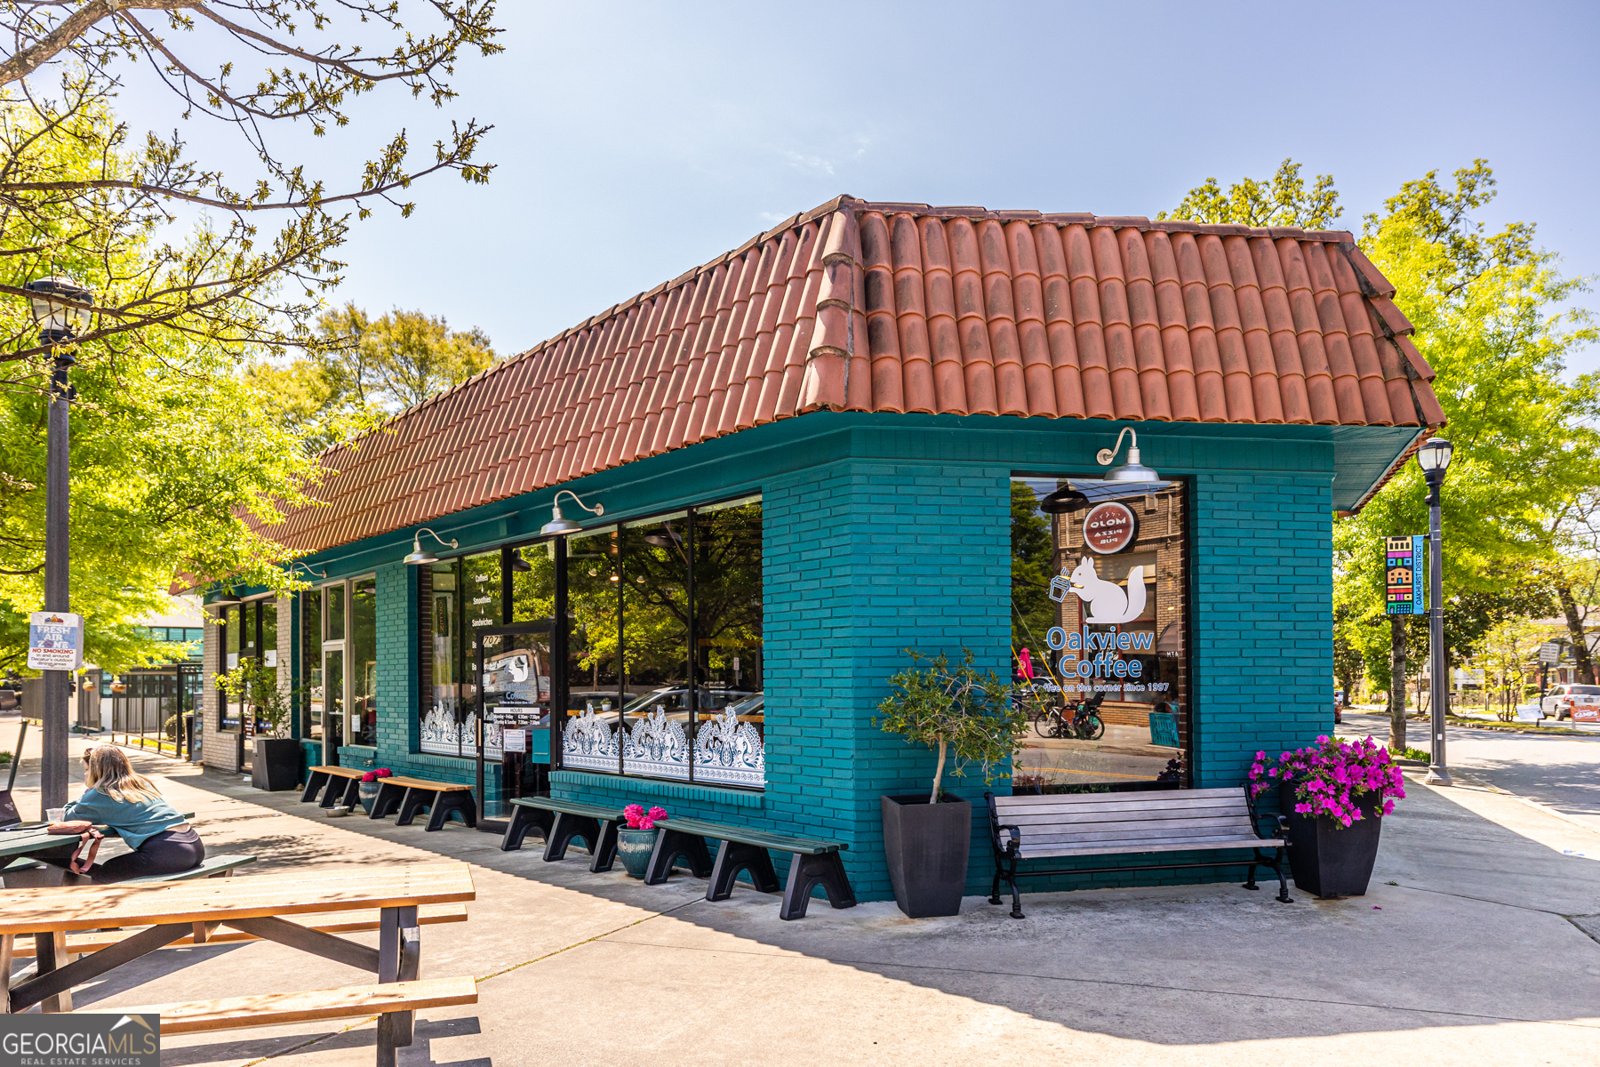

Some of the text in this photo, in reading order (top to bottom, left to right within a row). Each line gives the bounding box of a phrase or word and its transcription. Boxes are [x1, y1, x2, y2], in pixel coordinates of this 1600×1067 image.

[472, 618, 493, 627] Sandwiches
[37, 626, 71, 634] FRESH
[484, 636, 498, 644] 707
[1046, 625, 1154, 650] Oakview
[1059, 653, 1142, 678] Coffee
[1063, 684, 1075, 692] on
[1076, 682, 1092, 692] the
[1093, 684, 1121, 692] corner
